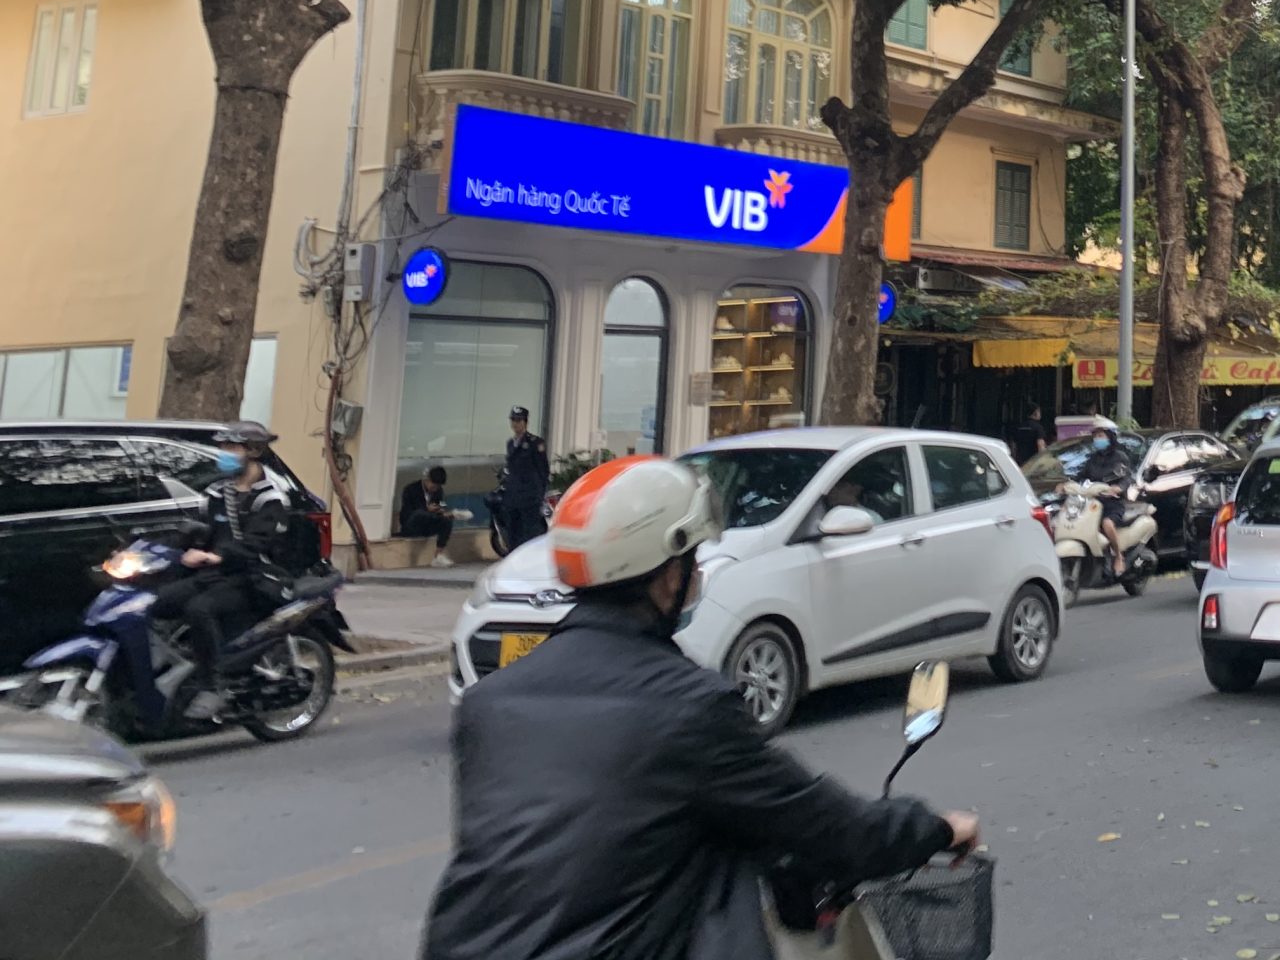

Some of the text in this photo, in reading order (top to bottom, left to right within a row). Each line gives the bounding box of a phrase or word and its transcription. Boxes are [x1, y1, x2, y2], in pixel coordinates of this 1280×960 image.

[466, 177, 515, 207] Ngân
[517, 183, 562, 214] hàng
[564, 189, 608, 215] Quốc
[704, 184, 768, 232] VIB
[406, 271, 429, 288] VIB
